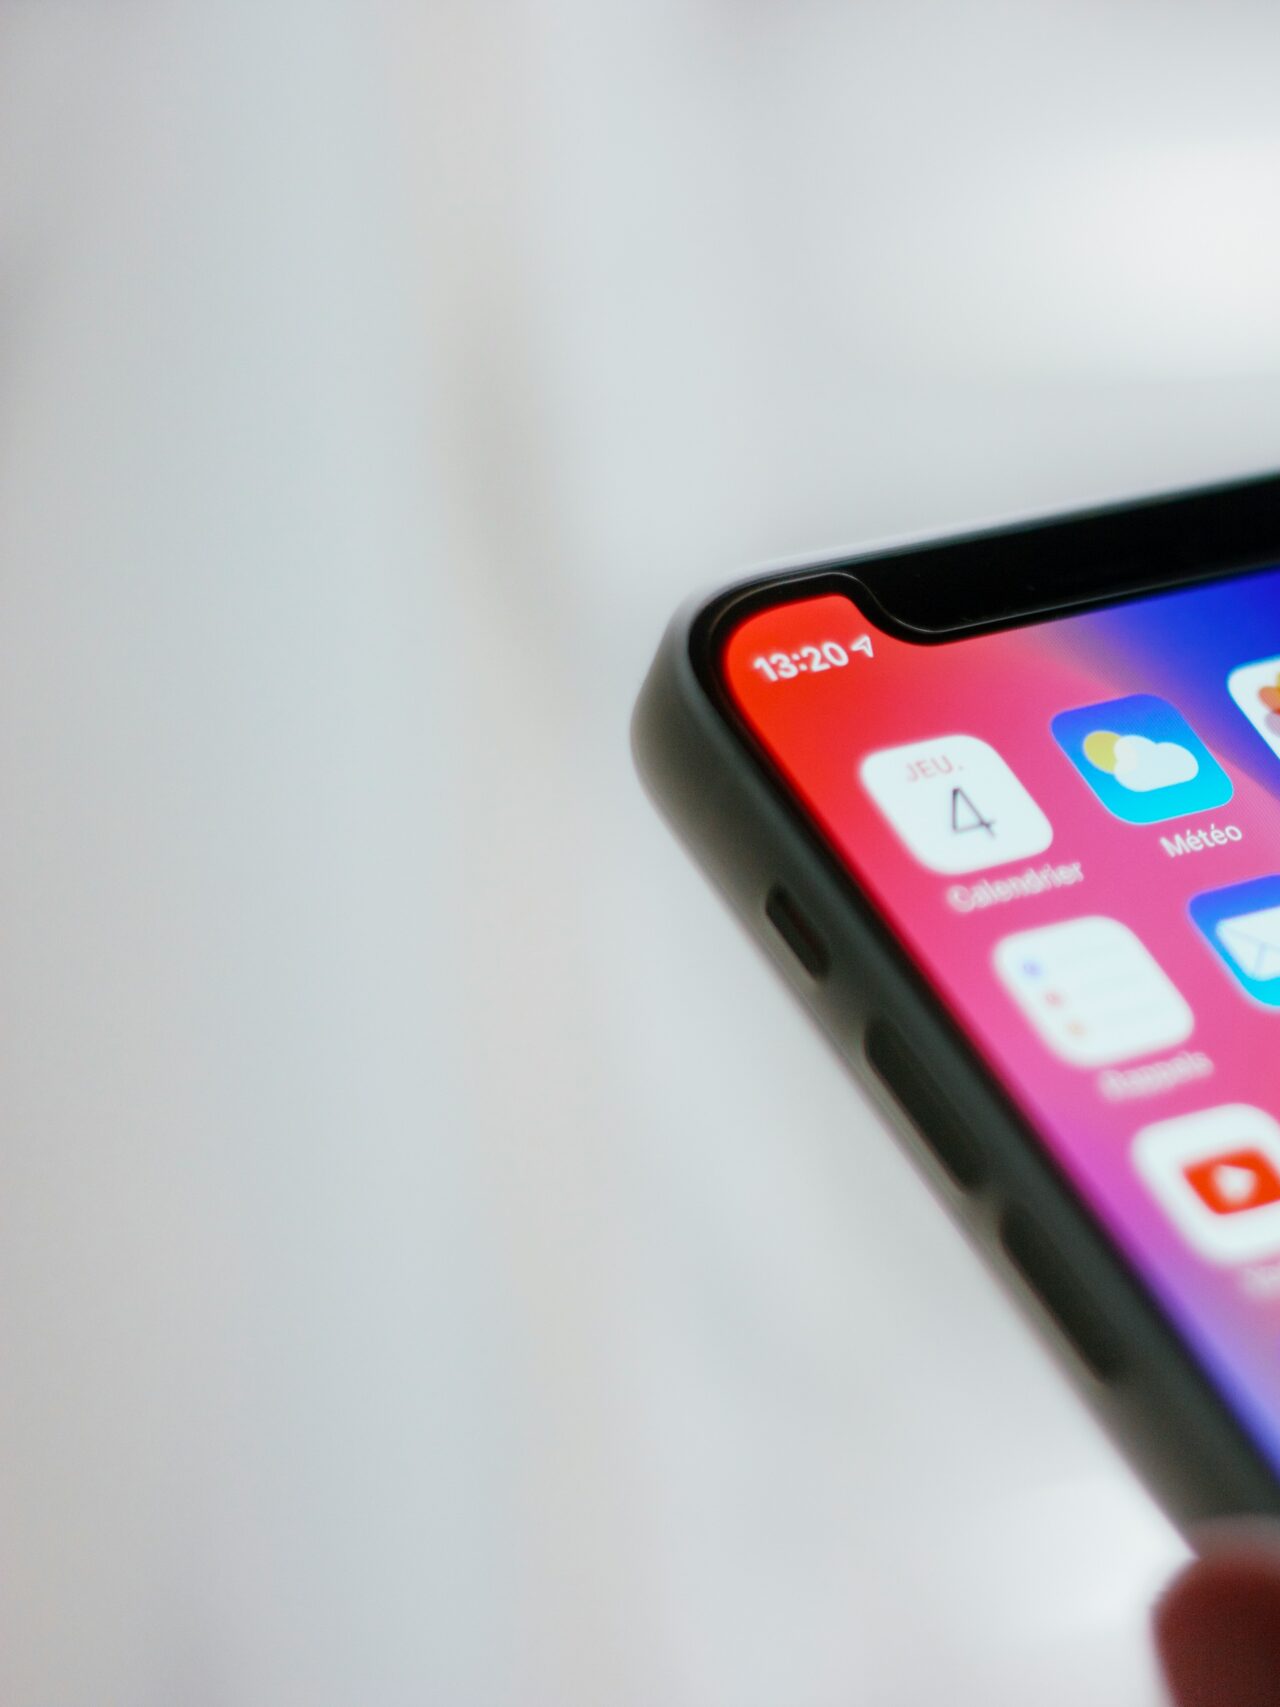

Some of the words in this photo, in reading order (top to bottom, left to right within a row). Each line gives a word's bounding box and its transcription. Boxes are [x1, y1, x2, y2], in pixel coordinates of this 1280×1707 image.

[754, 641, 849, 682] 13:20
[905, 755, 964, 783] JEU.
[951, 786, 996, 839] 4
[1159, 822, 1243, 858] Météo
[946, 861, 1085, 914] Calendrier
